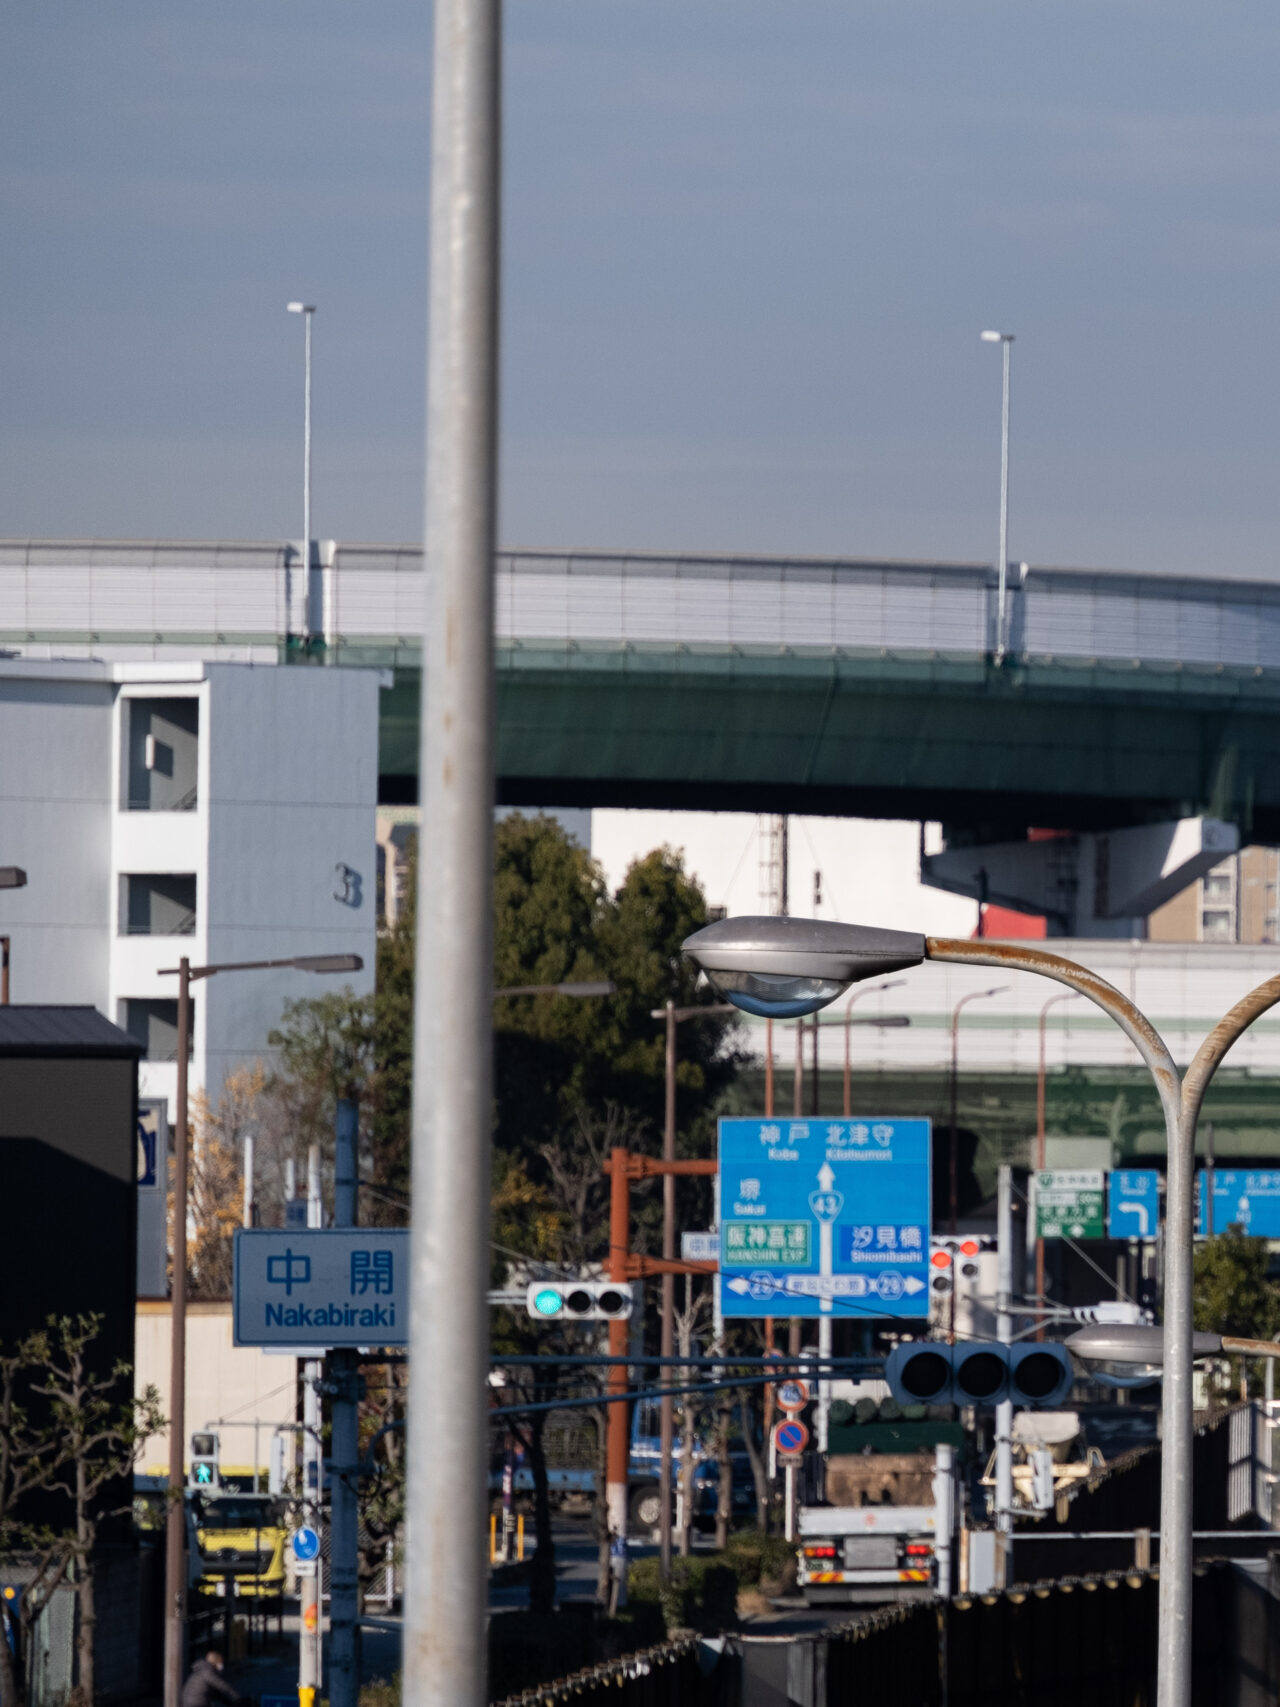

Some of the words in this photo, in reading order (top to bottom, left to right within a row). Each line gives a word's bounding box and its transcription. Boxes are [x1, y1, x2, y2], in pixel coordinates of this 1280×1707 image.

[760, 1123, 810, 1145] 神戸
[826, 1124, 894, 1146] 北津守
[768, 1149, 799, 1161] Kobe
[739, 1178, 761, 1200] 堺
[814, 1197, 838, 1215] 43
[728, 1226, 807, 1249] 阪神高速
[852, 1226, 921, 1248] 汐見橋
[267, 1248, 393, 1296] 中開
[265, 1303, 395, 1327] Nakabiraki
